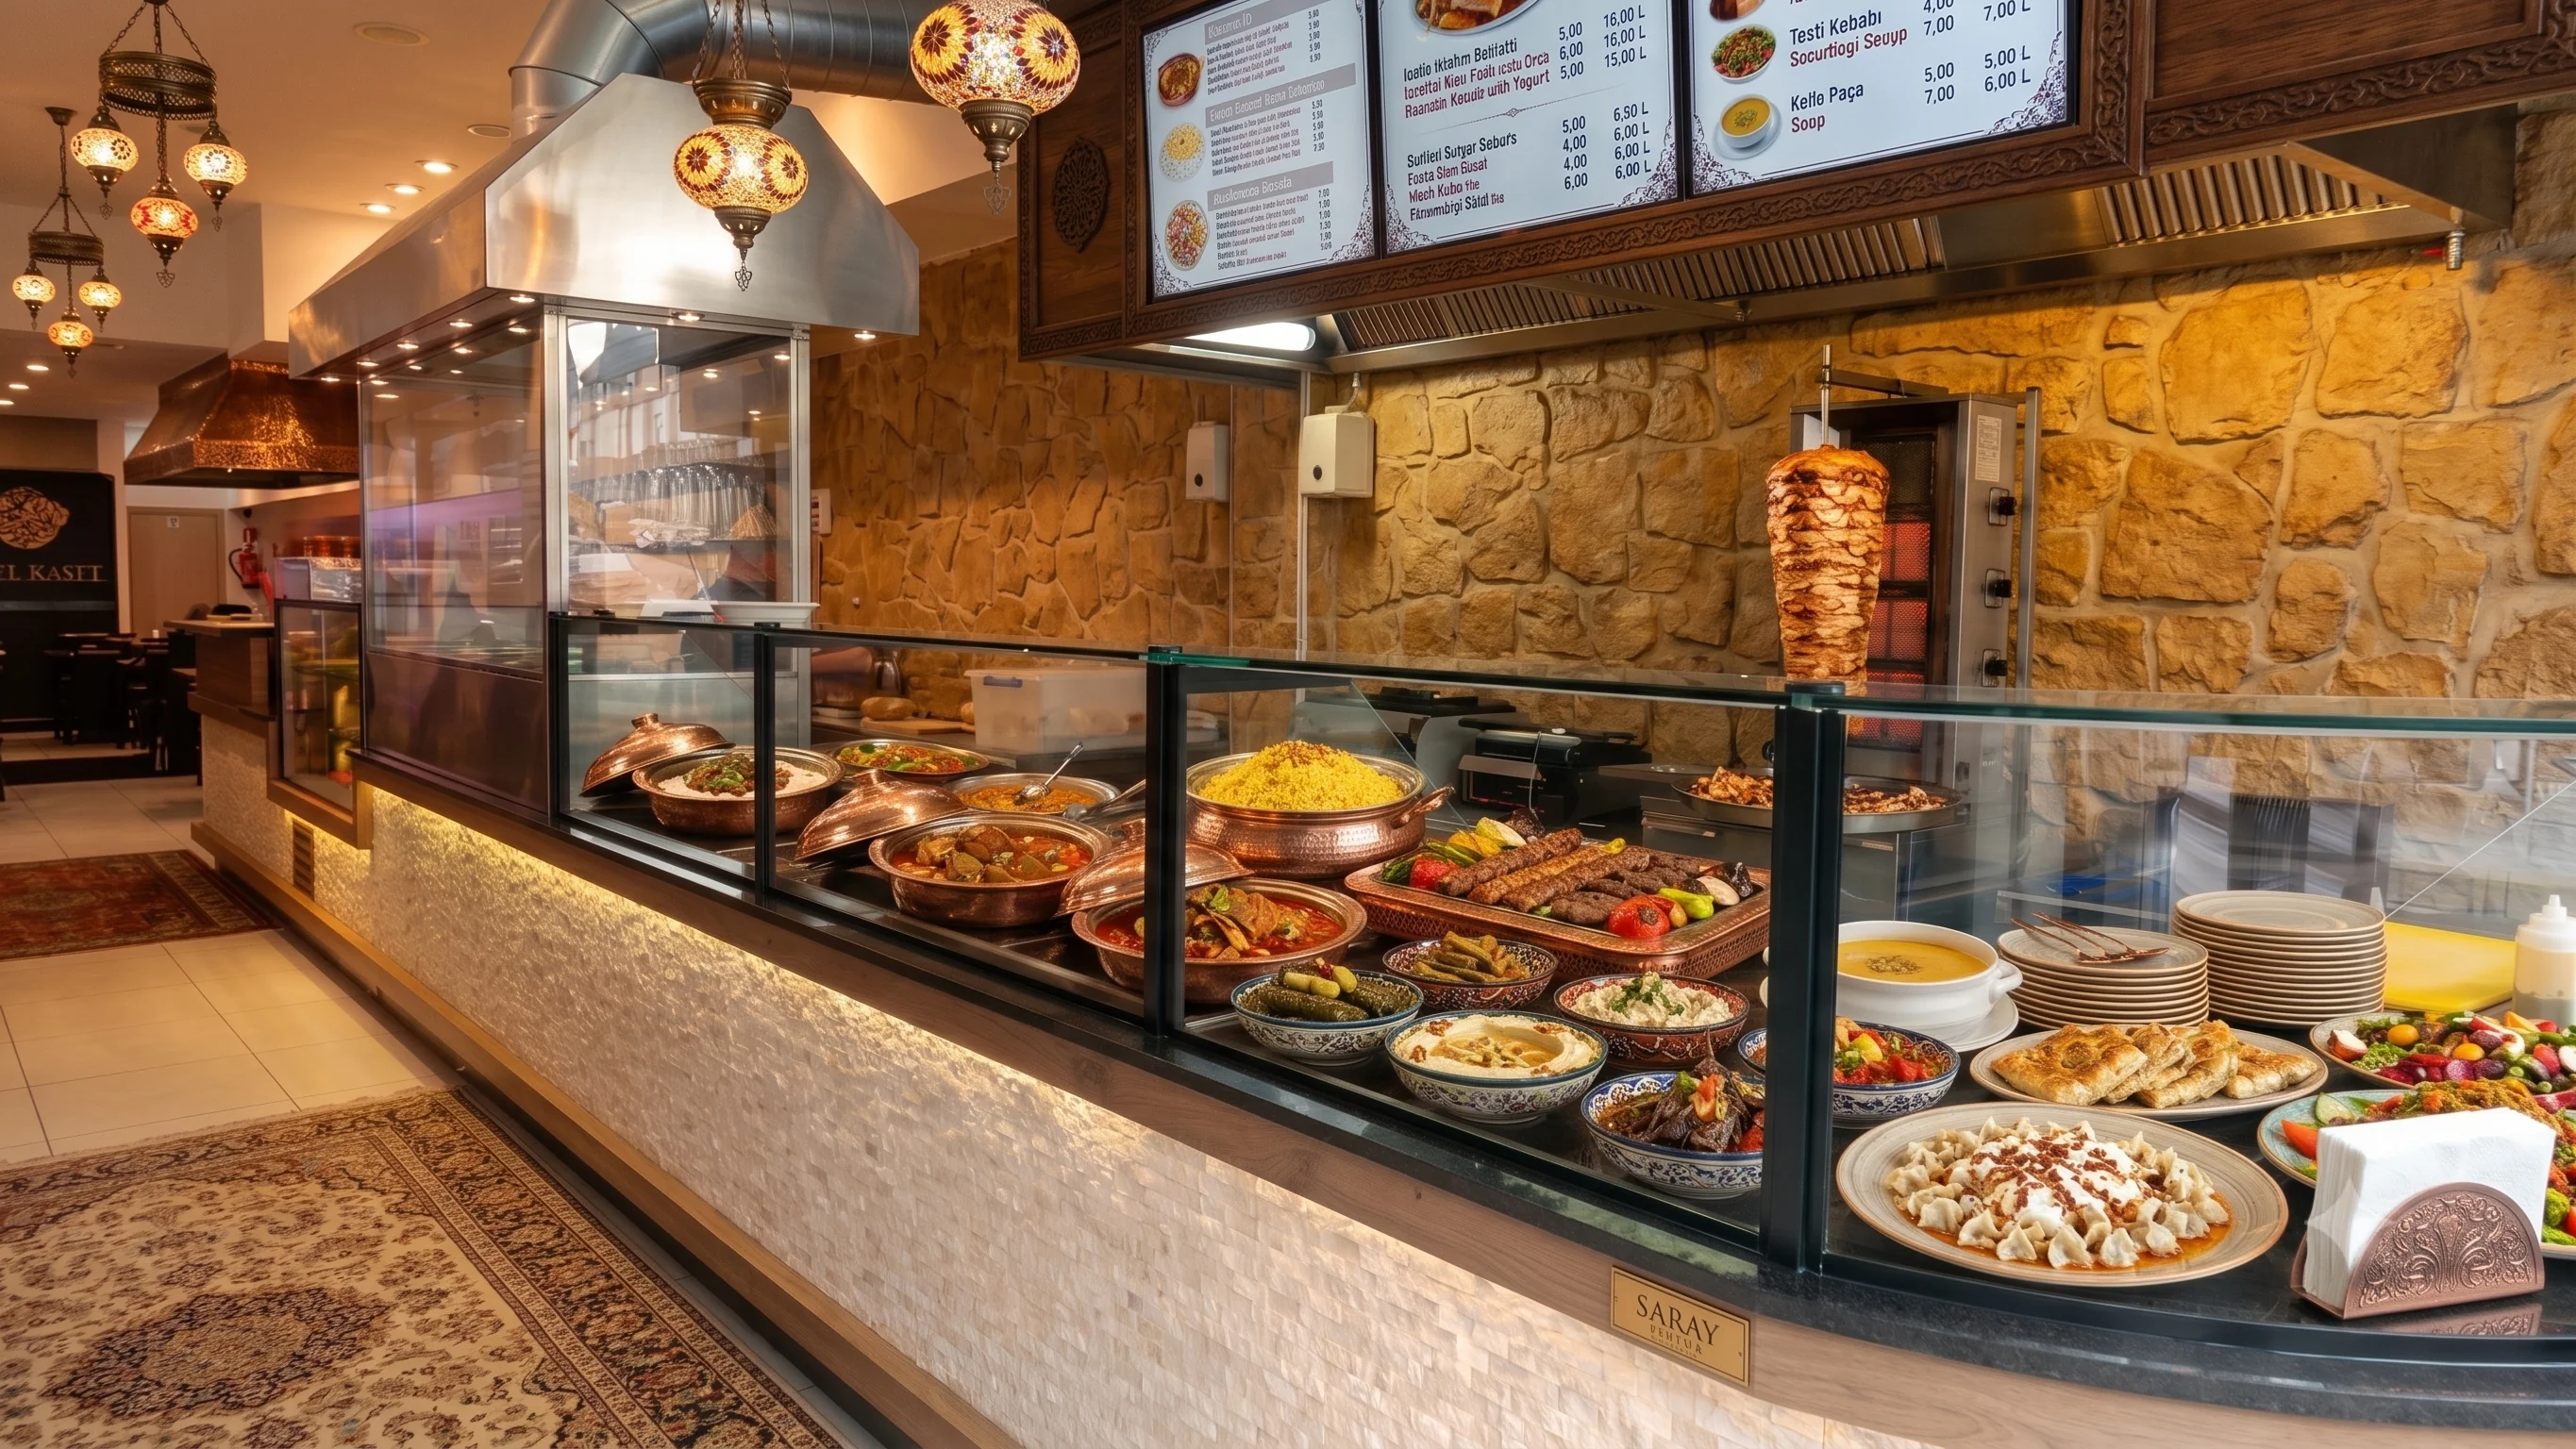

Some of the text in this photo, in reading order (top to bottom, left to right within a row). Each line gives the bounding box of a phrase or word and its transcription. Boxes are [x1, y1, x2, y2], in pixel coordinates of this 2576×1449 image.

[1603, 5, 1646, 28] 16,00 L
[1983, 0, 2031, 22] 7,00 L
[1559, 22, 1582, 42] 5,00
[1789, 21, 1825, 45] Testi
[1923, 14, 1954, 36] 7,00
[1603, 25, 1646, 48] 16,00 L
[1559, 42, 1583, 60] 6,00
[1604, 45, 1647, 68] 15,00 L
[1984, 45, 2031, 70] 5,00 L
[1561, 60, 1584, 79] 5,00
[1925, 62, 1954, 83] 5,00
[1984, 68, 2031, 92] 6,00 L
[1829, 83, 1865, 104] Paça
[1925, 85, 1955, 105] 7,00
[1642, 102, 1649, 115] L
[1563, 115, 1586, 134] 5,00
[1614, 121, 1649, 142] 6,00 L
[1563, 134, 1587, 153] 4,00
[1614, 141, 1651, 160] 6,00 L
[1564, 153, 1587, 172] 4,00
[1615, 160, 1651, 180] 6,00 L
[1564, 172, 1588, 191] 6,00
[1636, 1293, 1719, 1347] SARAY
